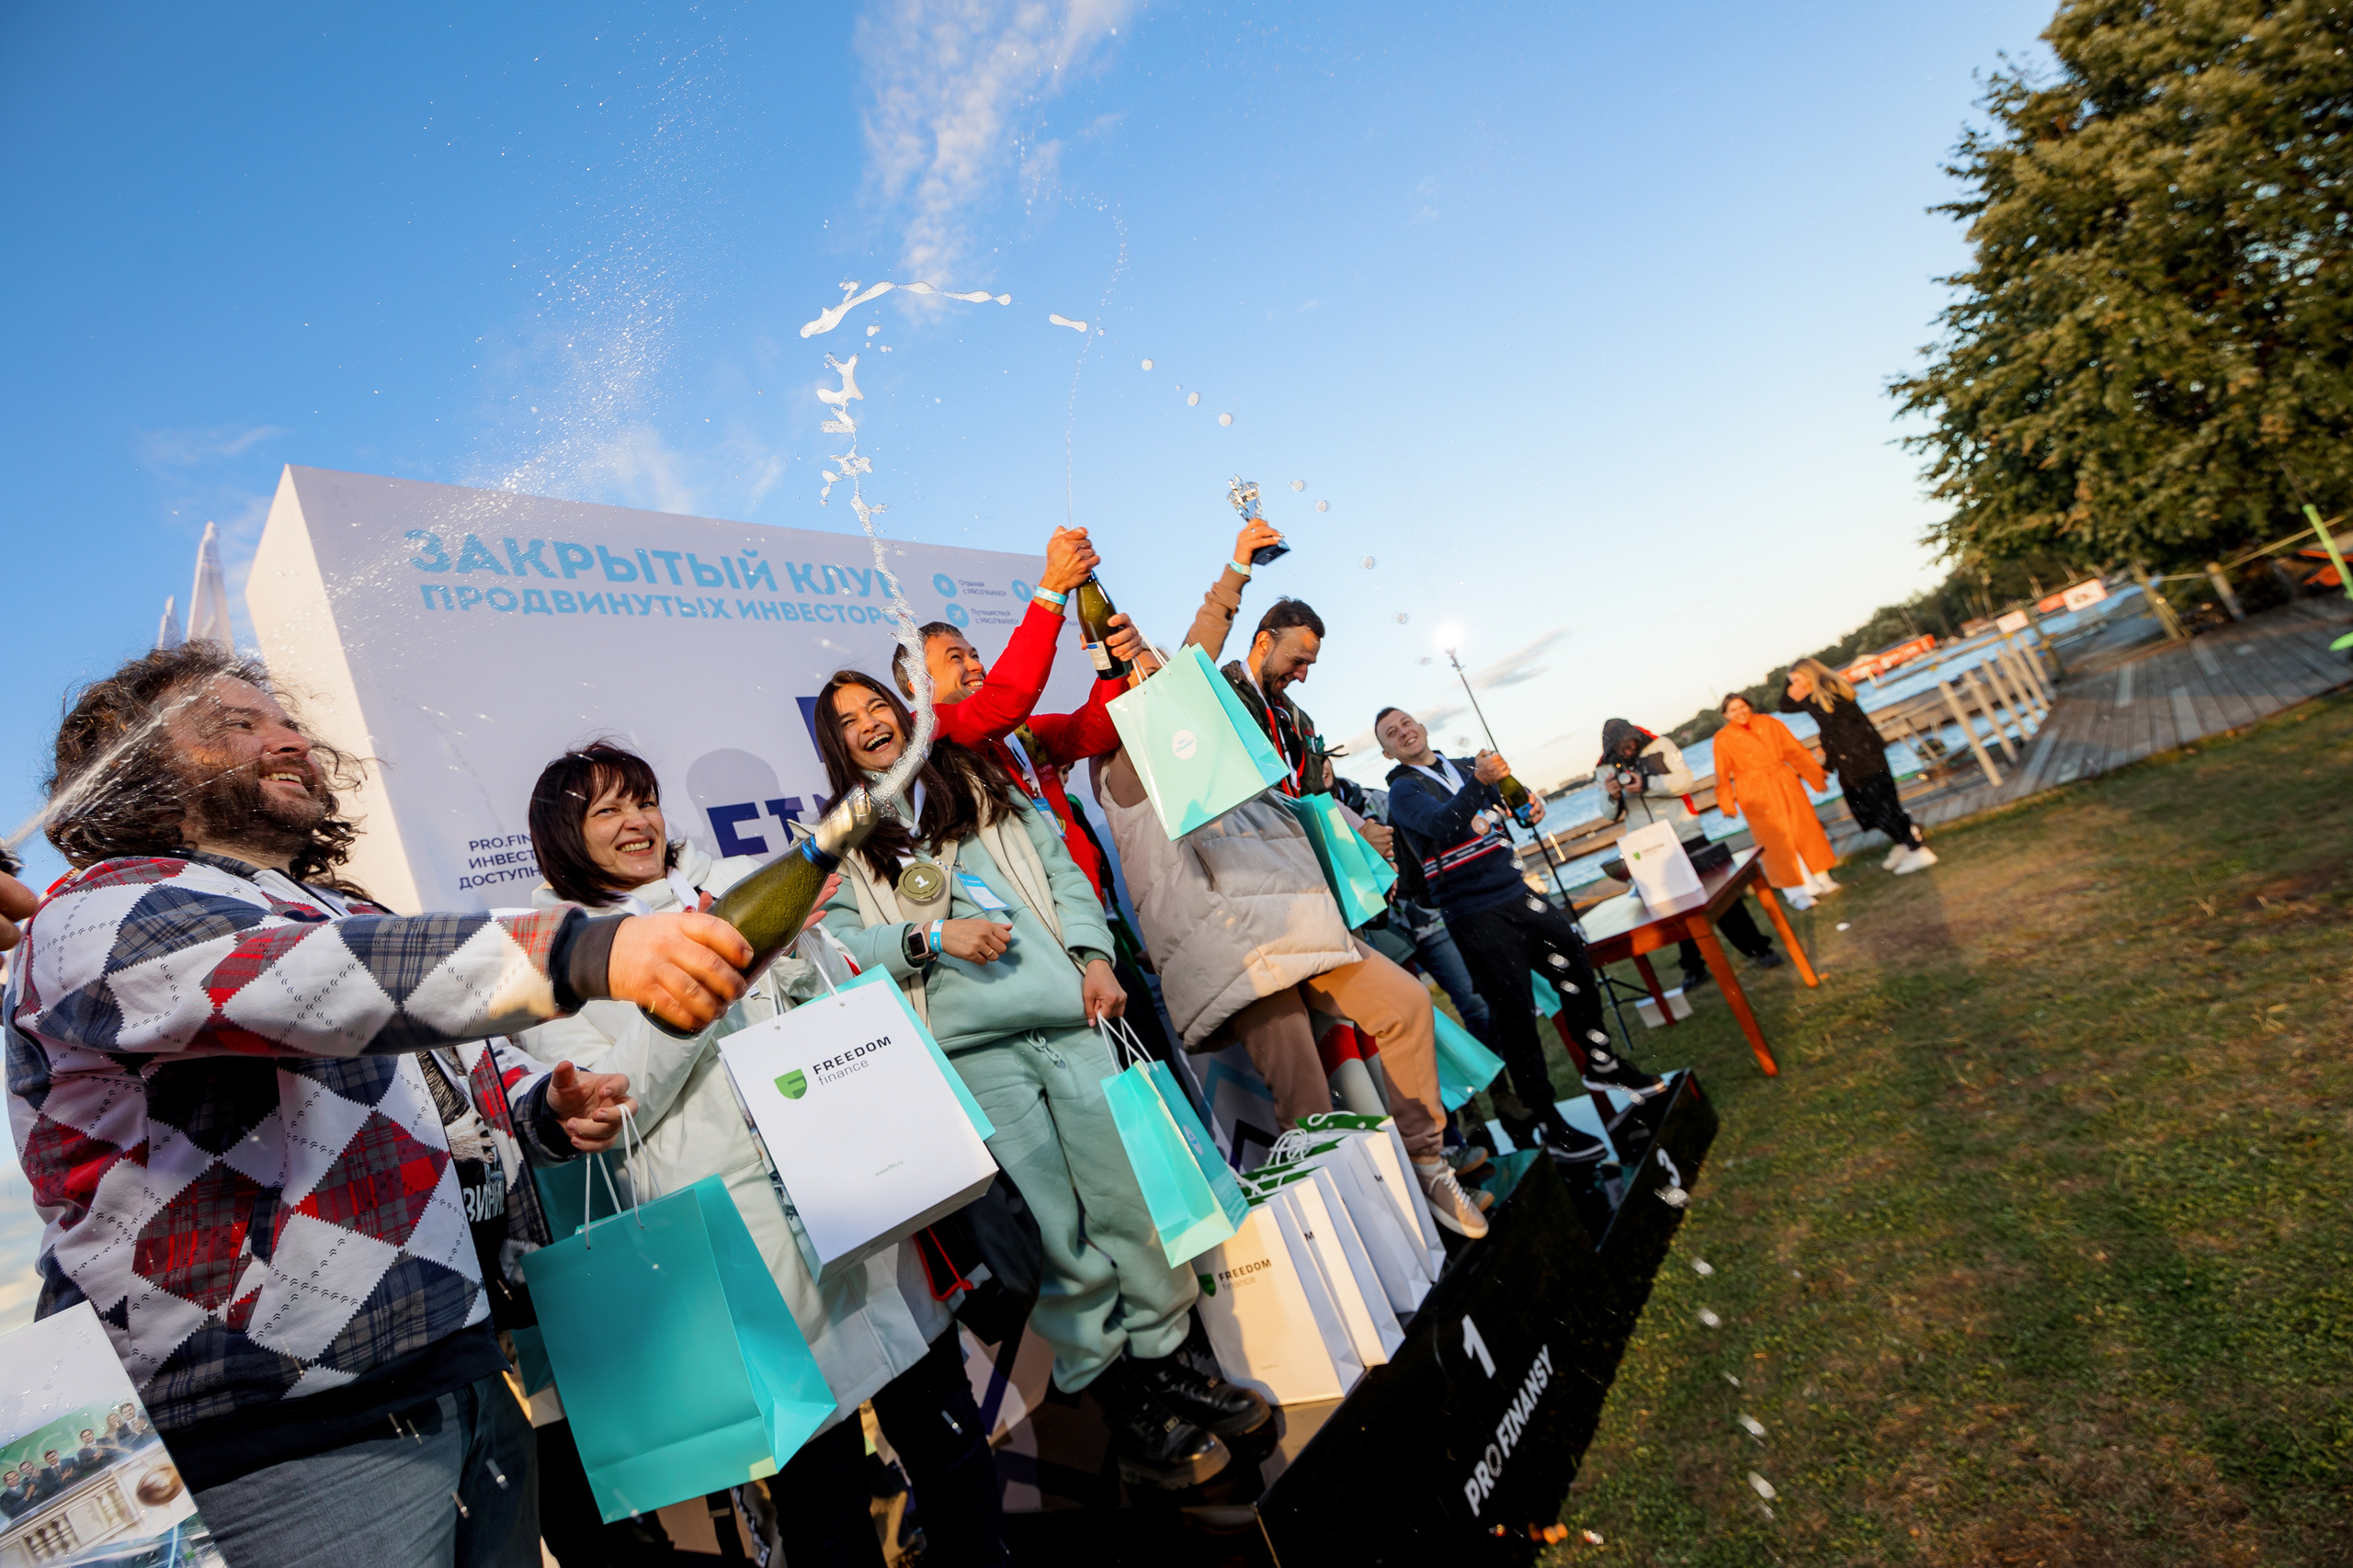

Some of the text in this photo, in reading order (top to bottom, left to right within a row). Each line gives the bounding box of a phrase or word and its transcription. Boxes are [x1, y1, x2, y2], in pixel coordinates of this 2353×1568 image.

[404, 528, 779, 592] ЗАКРЫТЫЙ
[420, 584, 916, 626] ПРОДВИНУТЫХ ИНВЕСТОРО
[915, 875, 929, 888] 1
[813, 1036, 892, 1074] FREEDOM
[818, 1058, 870, 1085] finance
[1656, 1148, 1681, 1188] 3
[1218, 1258, 1272, 1282] FREEDOM
[1222, 1277, 1256, 1291] finance
[1461, 1313, 1496, 1380] 1
[1495, 1343, 1553, 1460] FINANSY
